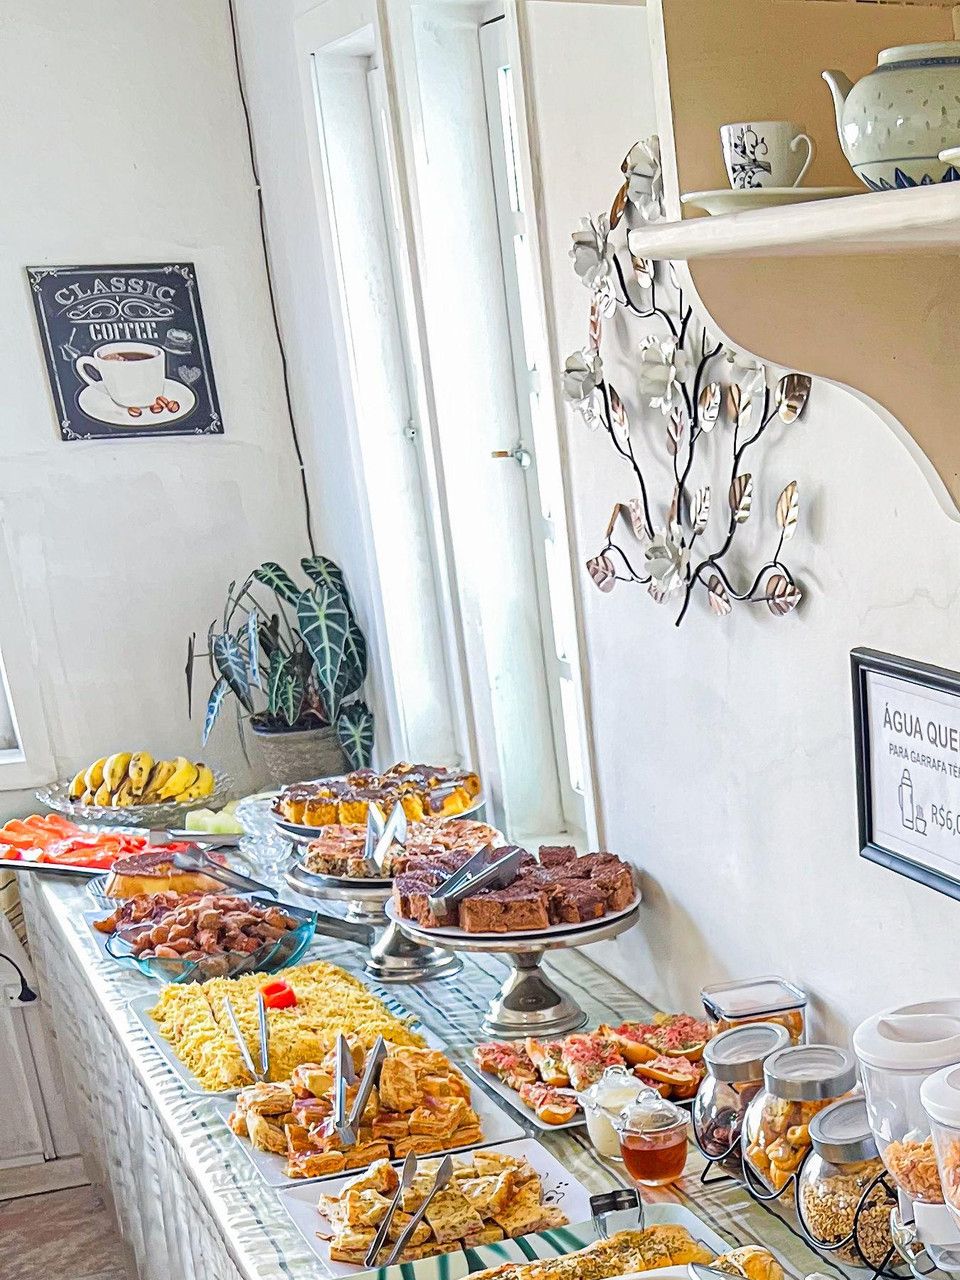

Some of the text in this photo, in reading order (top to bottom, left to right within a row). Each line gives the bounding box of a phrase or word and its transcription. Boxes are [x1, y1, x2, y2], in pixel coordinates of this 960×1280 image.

[55, 277, 176, 306] CLASSIC
[89, 321, 159, 341] COFFEE
[883, 702, 924, 742] ÁGUA
[889, 743, 909, 761] PARA
[910, 750, 948, 775] GARRAFA
